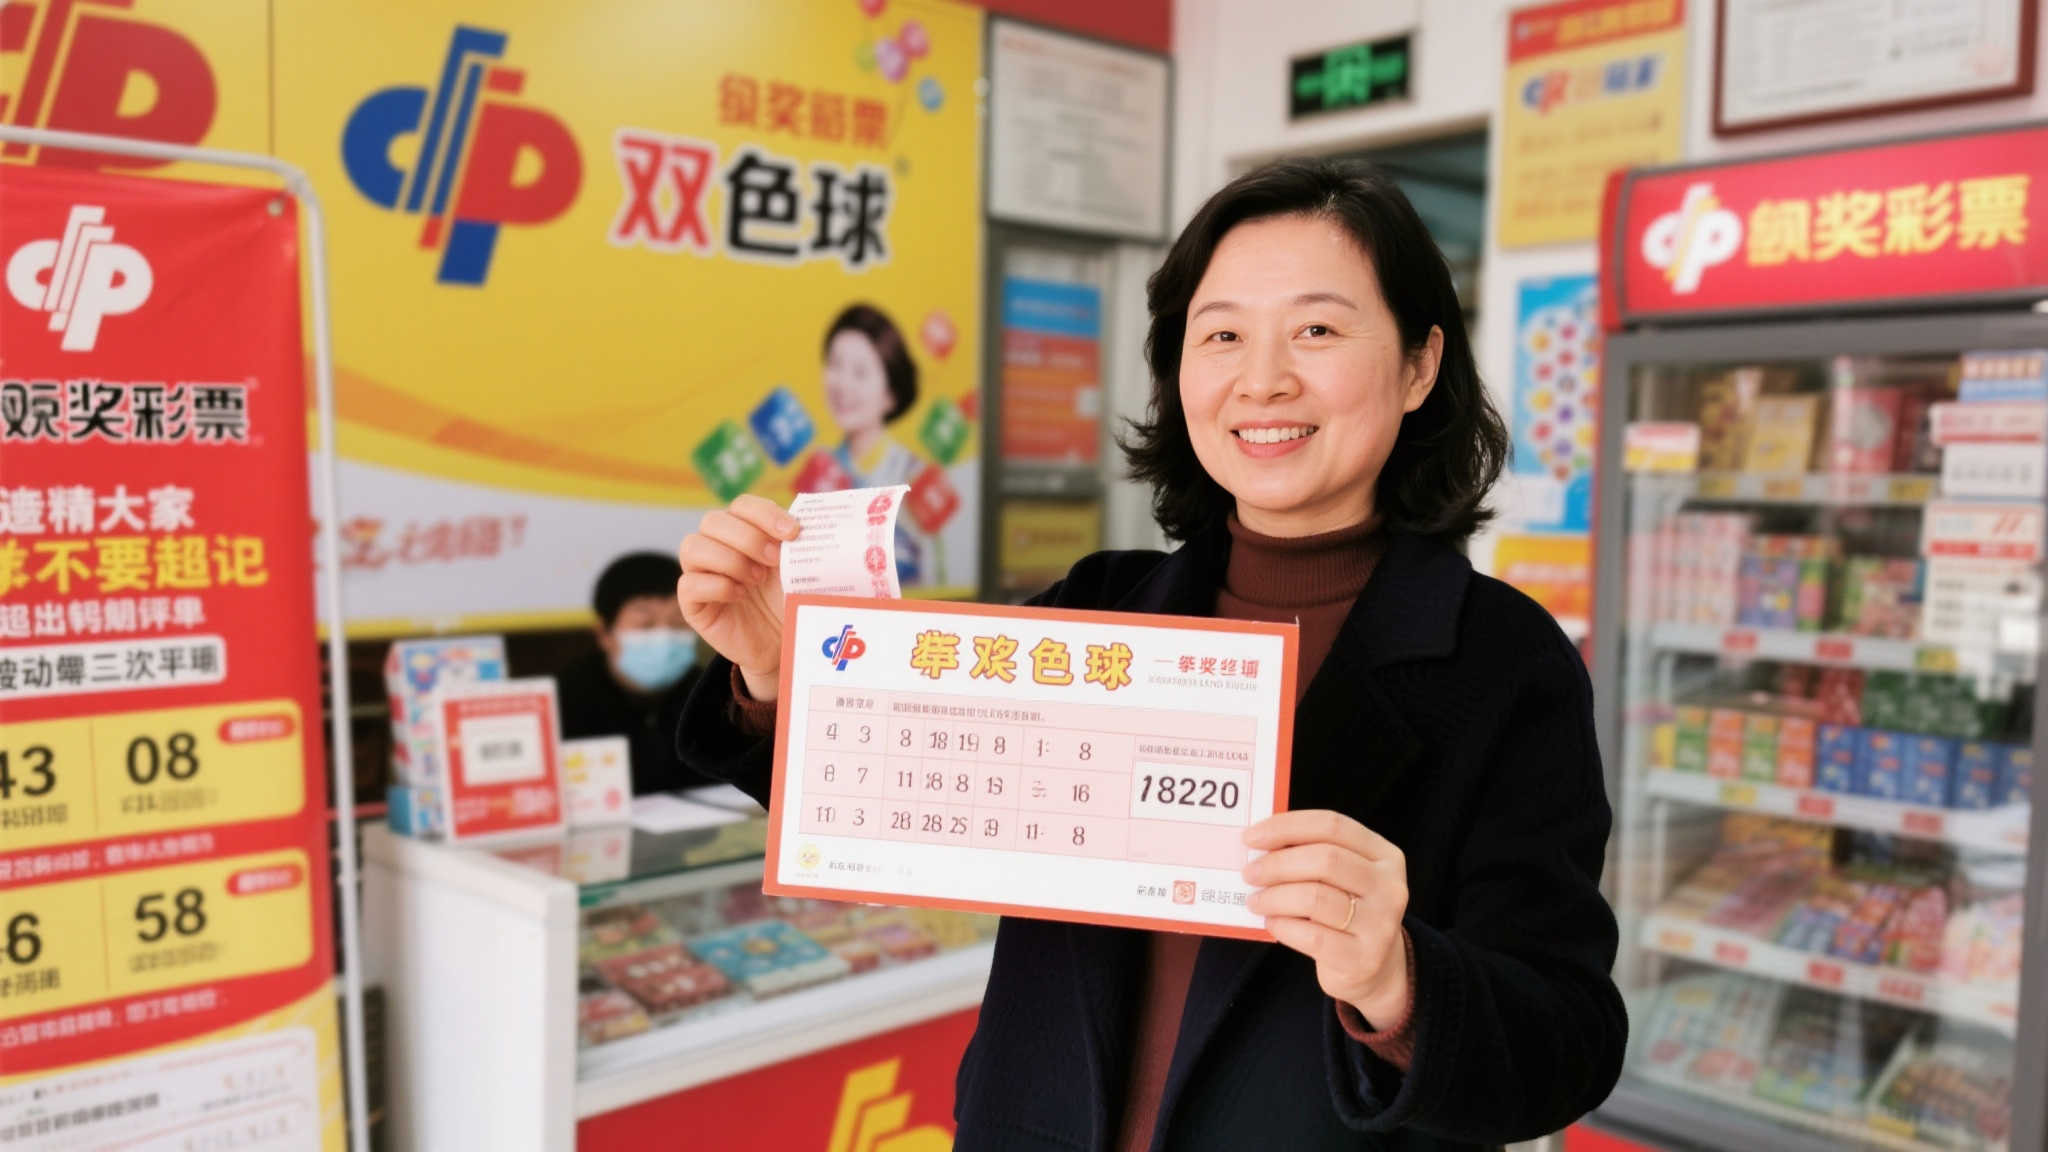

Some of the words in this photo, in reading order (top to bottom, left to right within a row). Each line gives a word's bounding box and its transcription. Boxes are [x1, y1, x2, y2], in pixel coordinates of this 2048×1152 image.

[611, 131, 890, 267] 双色球
[125, 731, 200, 786] 08
[858, 725, 871, 744] 3
[900, 728, 912, 748] 8
[994, 736, 1006, 755] 8
[1079, 742, 1092, 761] 8
[857, 767, 869, 785] 7
[898, 771, 913, 789] 11
[956, 774, 969, 793] 8
[1073, 784, 1091, 803] 16
[1139, 775, 1240, 810] 18220
[852, 808, 866, 827] 3
[1072, 826, 1086, 846] 8
[134, 886, 207, 944] 58
[0, 912, 43, 966] 6
